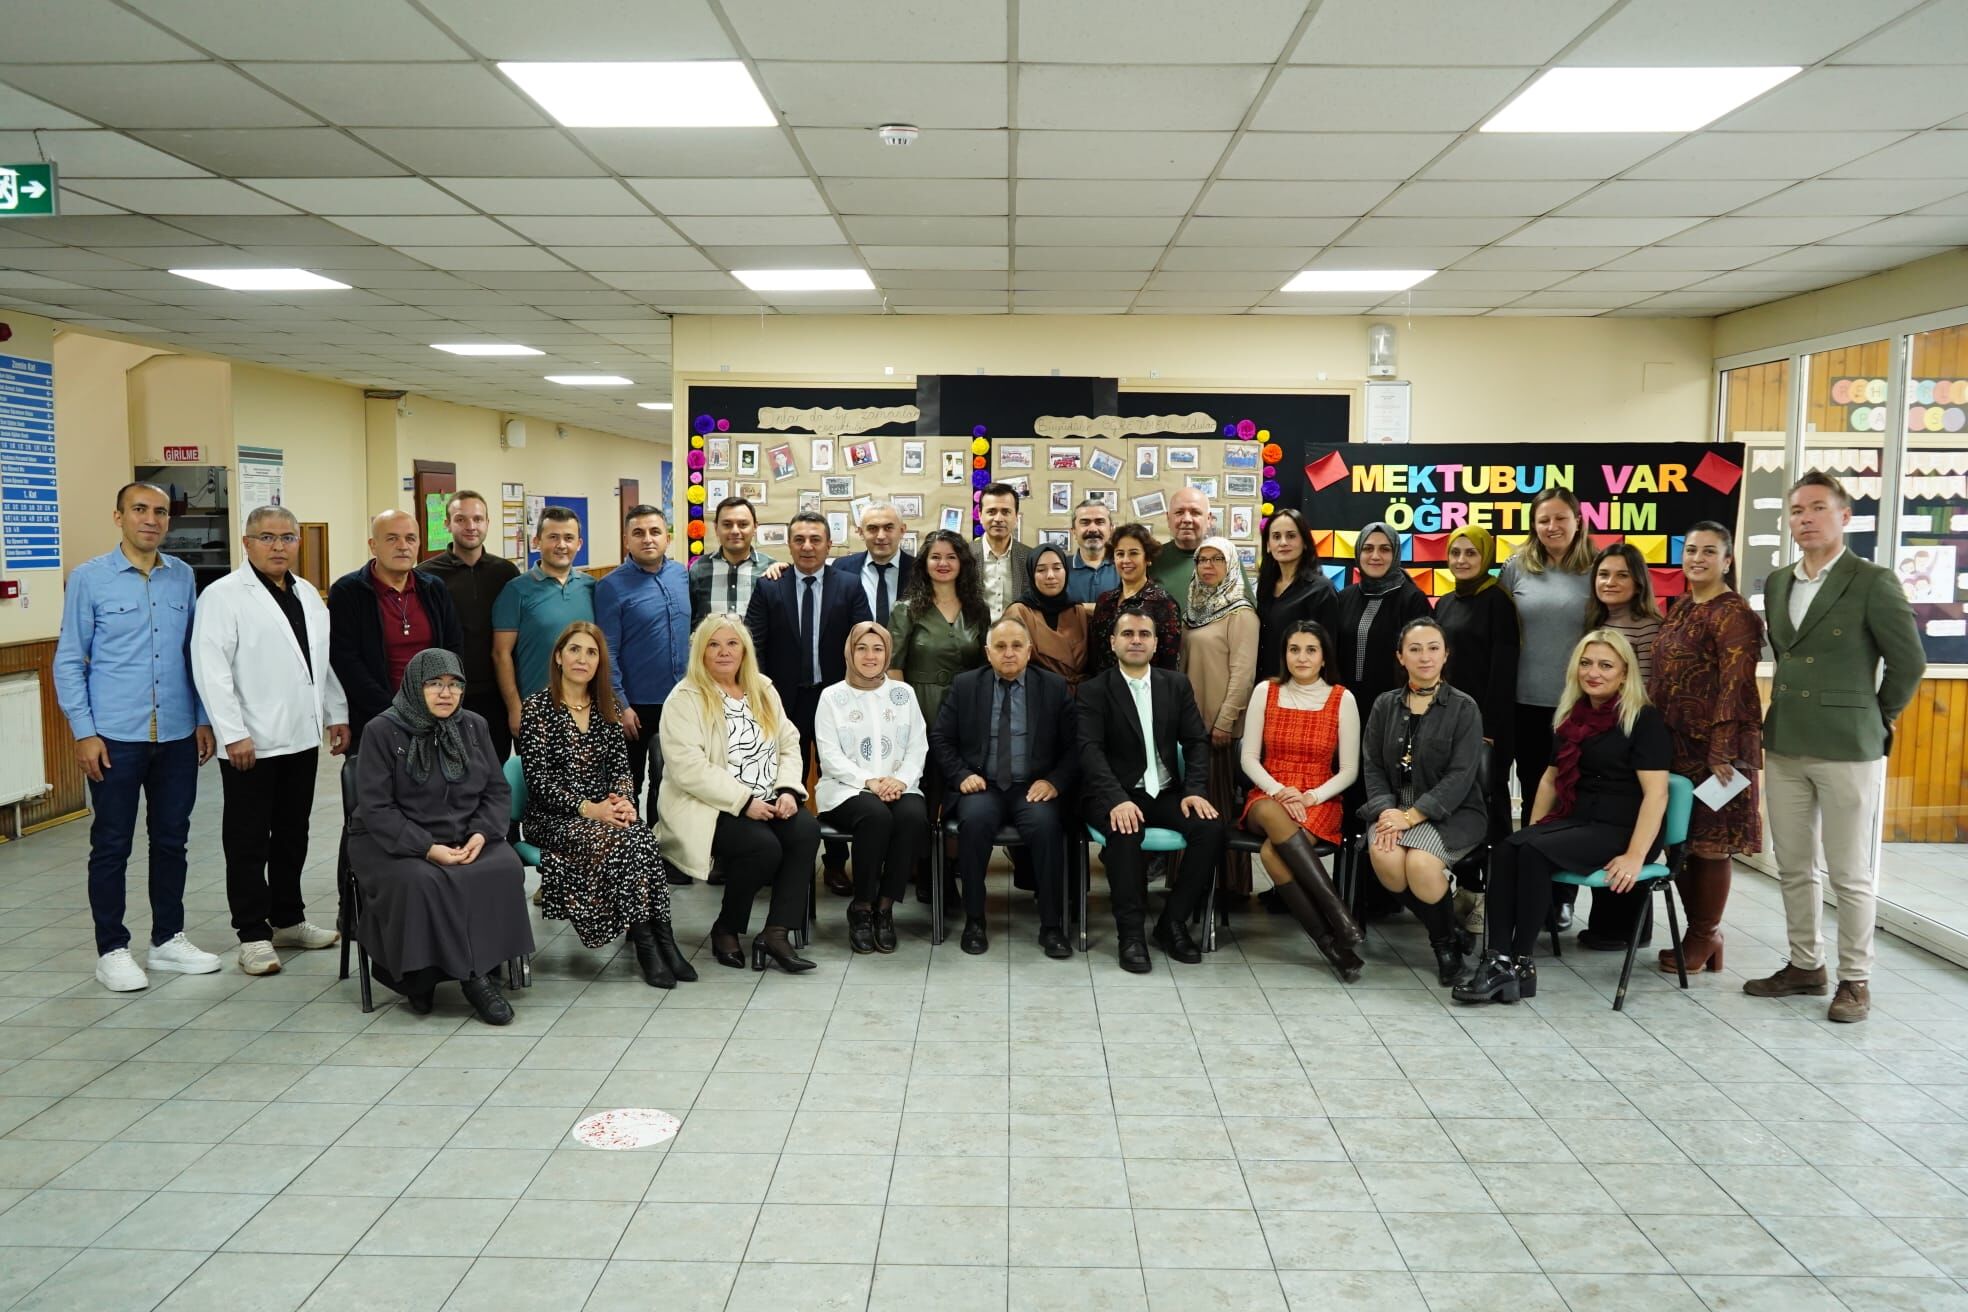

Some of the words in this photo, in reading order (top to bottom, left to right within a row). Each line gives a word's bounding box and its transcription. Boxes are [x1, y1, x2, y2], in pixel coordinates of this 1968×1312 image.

[1351, 464, 1574, 494] MEKTUBUN
[1601, 463, 1688, 493] VAR
[1384, 496, 1657, 532] ÖĞRETNİM
